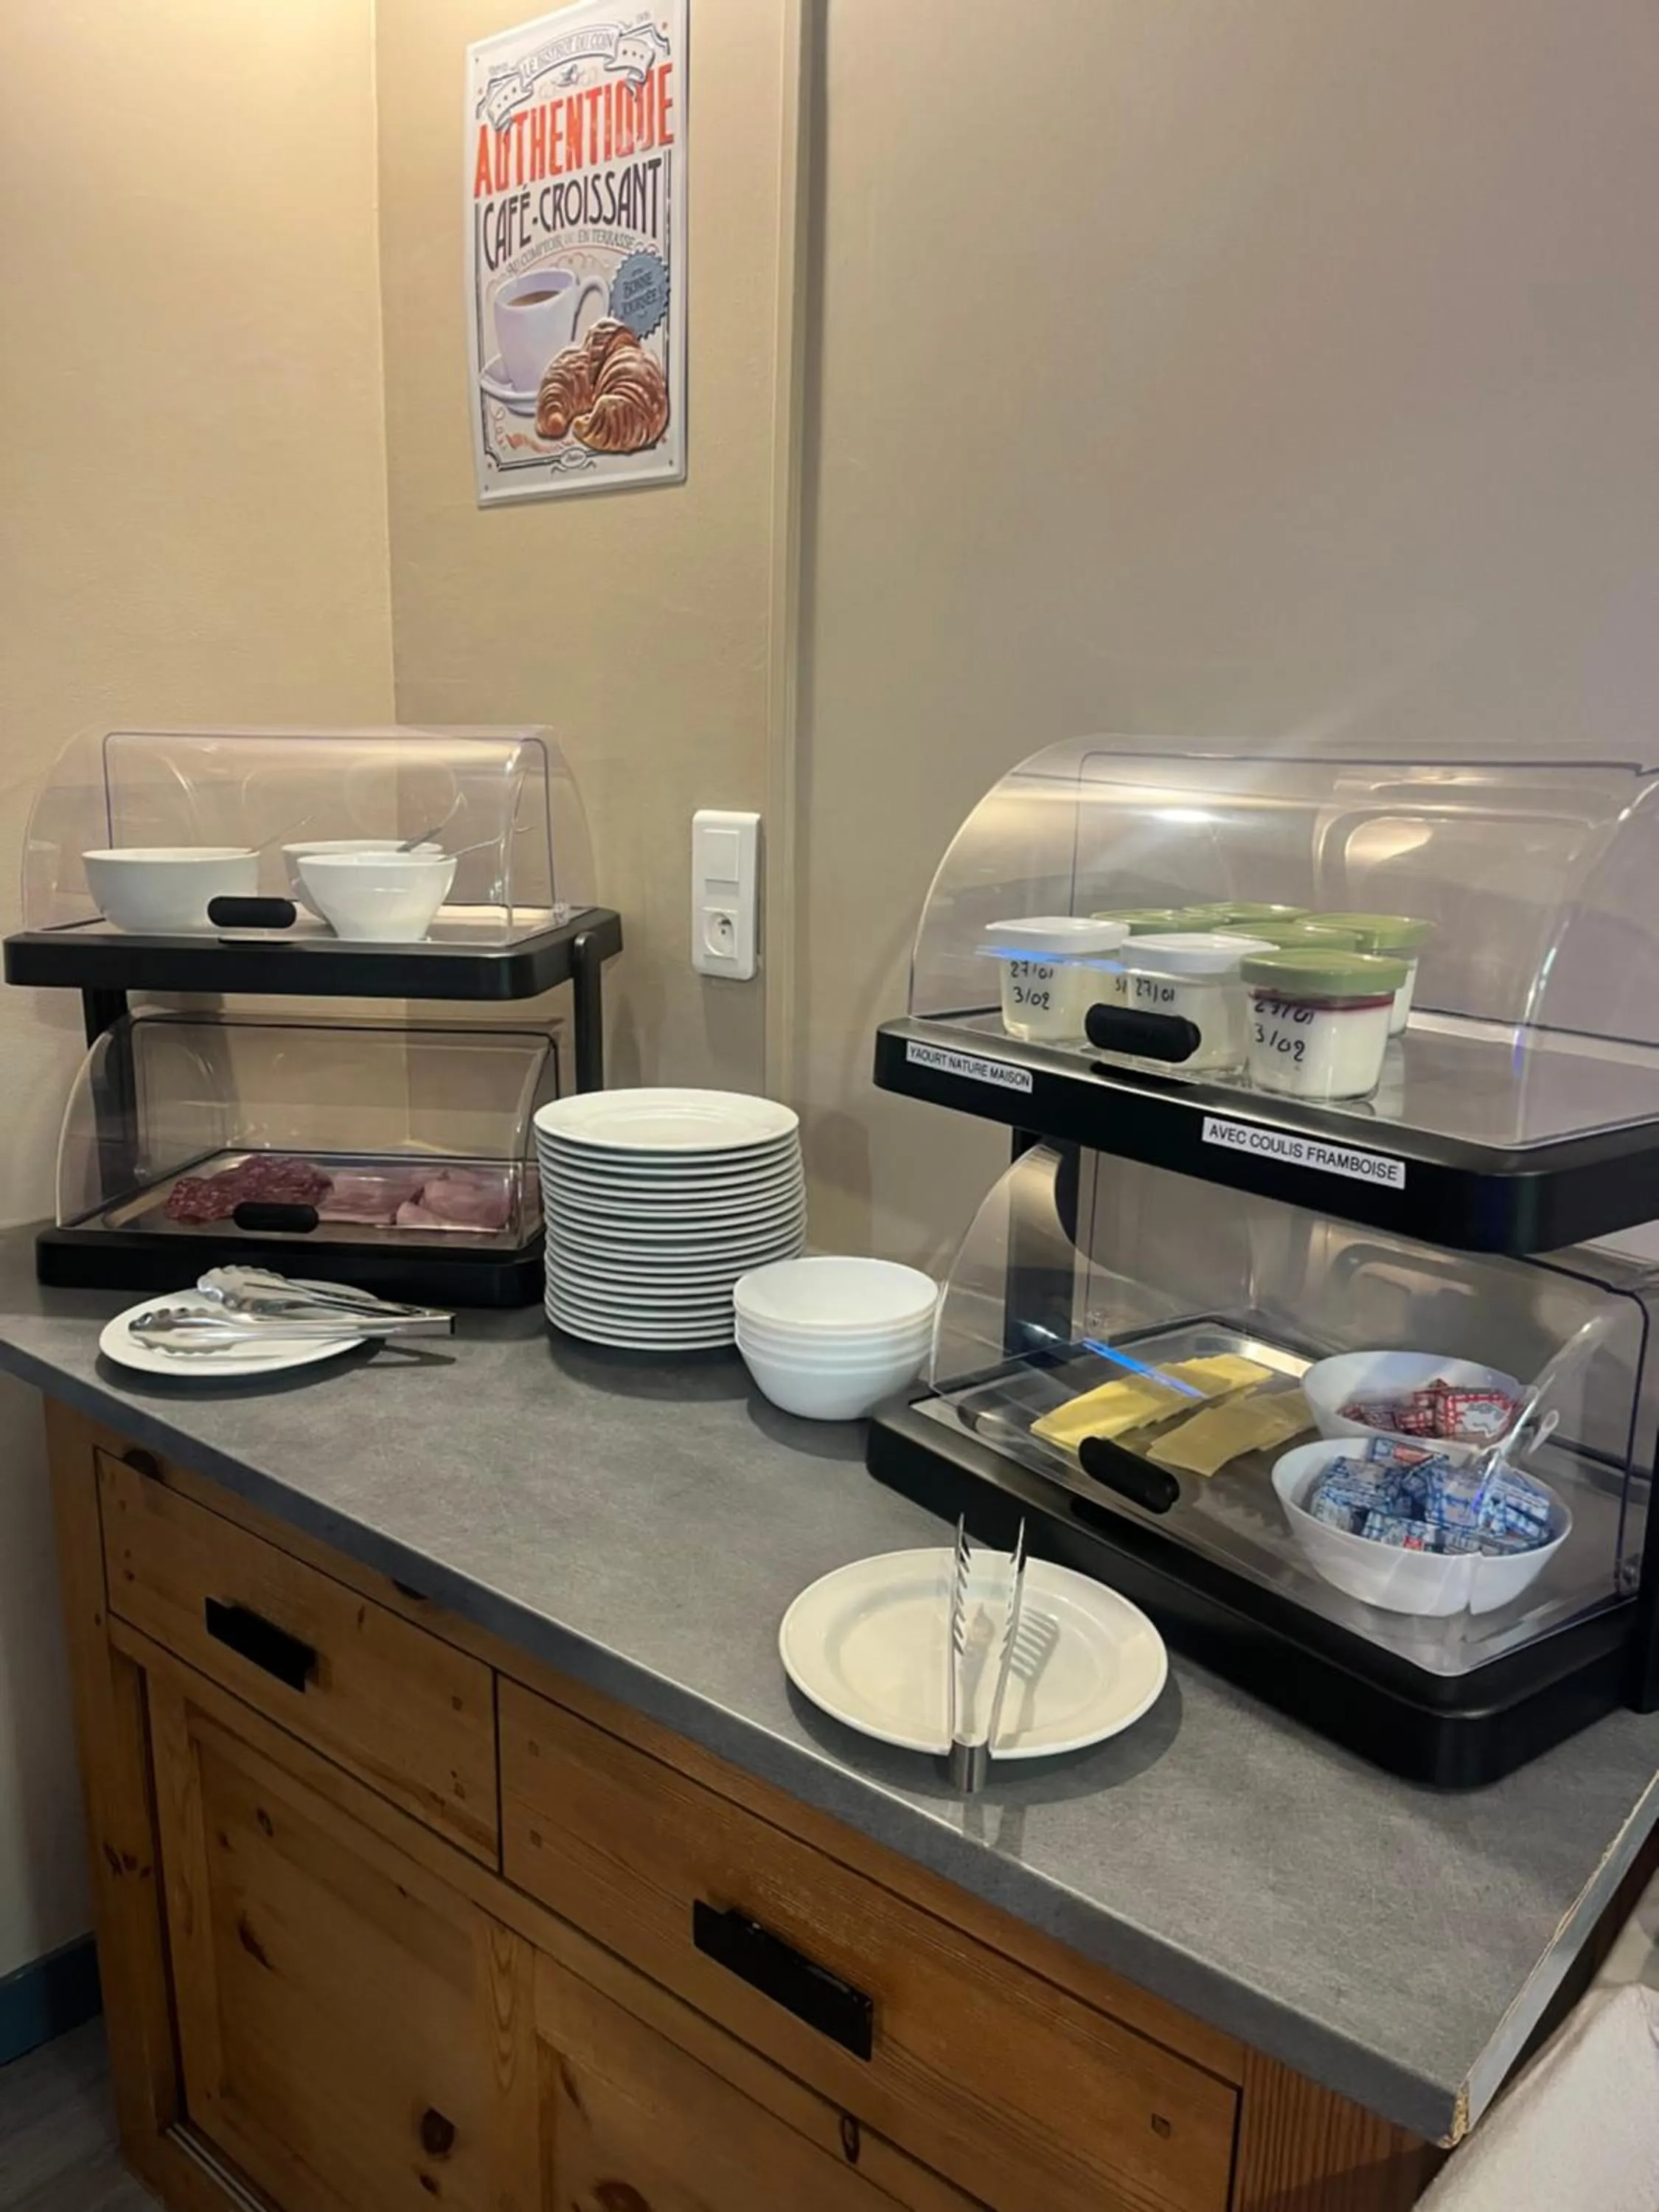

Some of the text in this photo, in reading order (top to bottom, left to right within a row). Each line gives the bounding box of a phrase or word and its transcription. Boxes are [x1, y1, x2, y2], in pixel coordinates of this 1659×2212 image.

[474, 63, 674, 198] AUTHENTIQUE
[1013, 987, 1050, 1010] 3/02
[1255, 1023, 1305, 1062] 3/02
[910, 1046, 1030, 1088] YAOURT NATURE MAISON
[1208, 1124, 1399, 1181] AVEC COULIS FRAMBOISE
